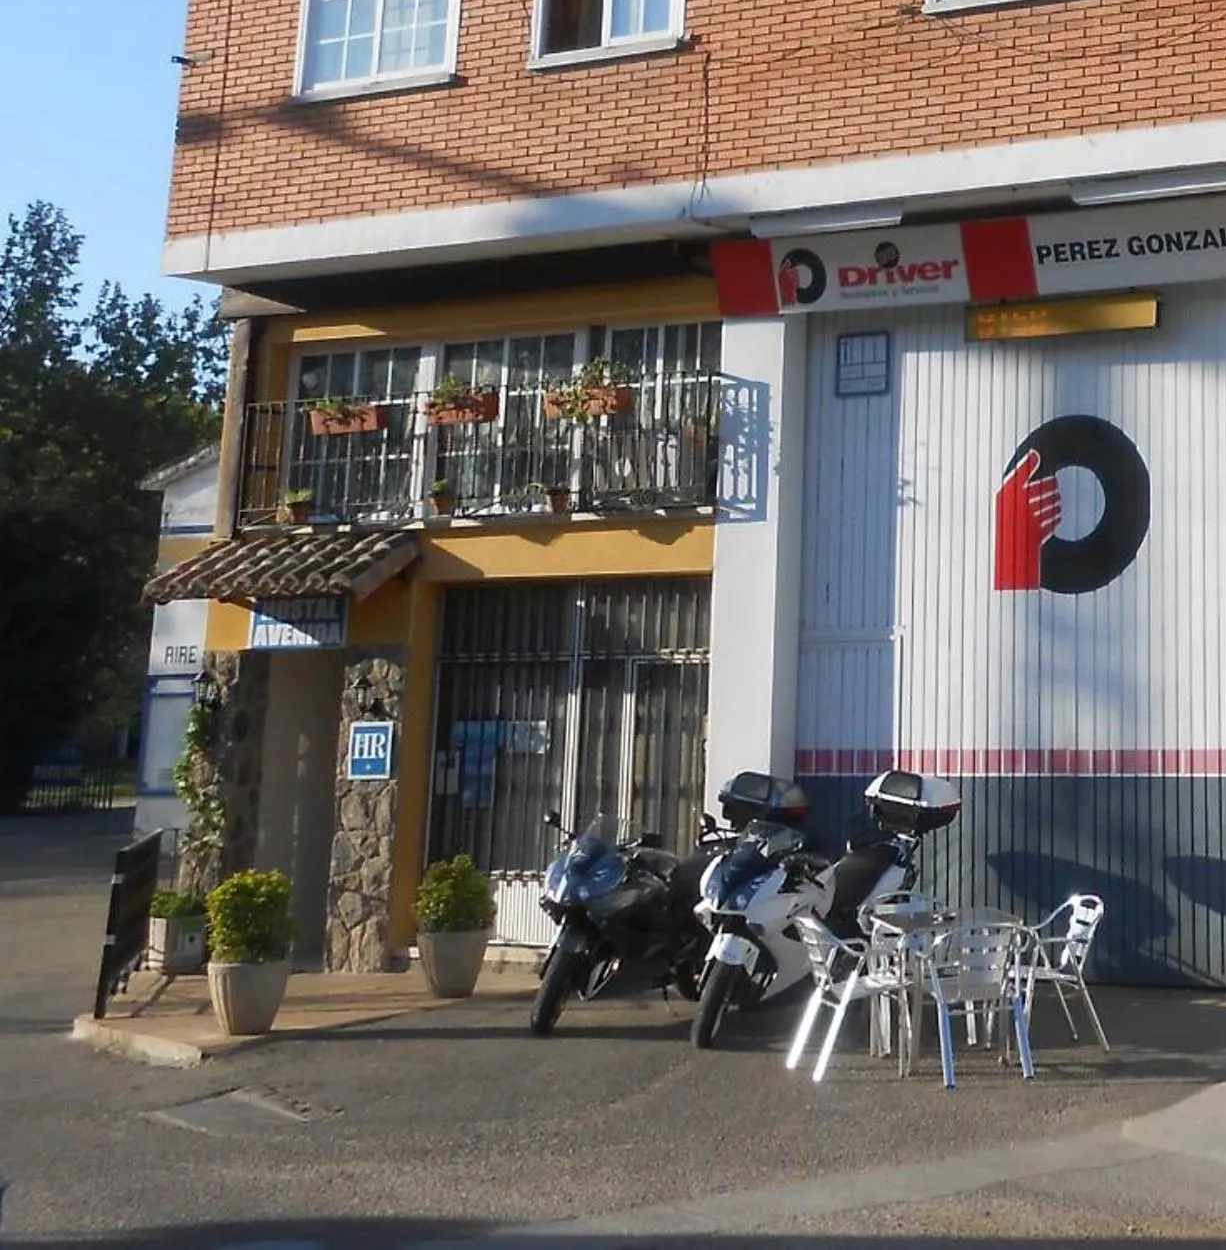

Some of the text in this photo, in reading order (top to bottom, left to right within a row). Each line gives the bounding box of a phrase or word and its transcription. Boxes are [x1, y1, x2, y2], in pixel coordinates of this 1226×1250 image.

[1036, 237, 1120, 265] PEREZ
[837, 243, 959, 288] Driver
[253, 622, 340, 646] AVENIDA
[164, 645, 198, 665] AIRE
[353, 732, 387, 759] HR
